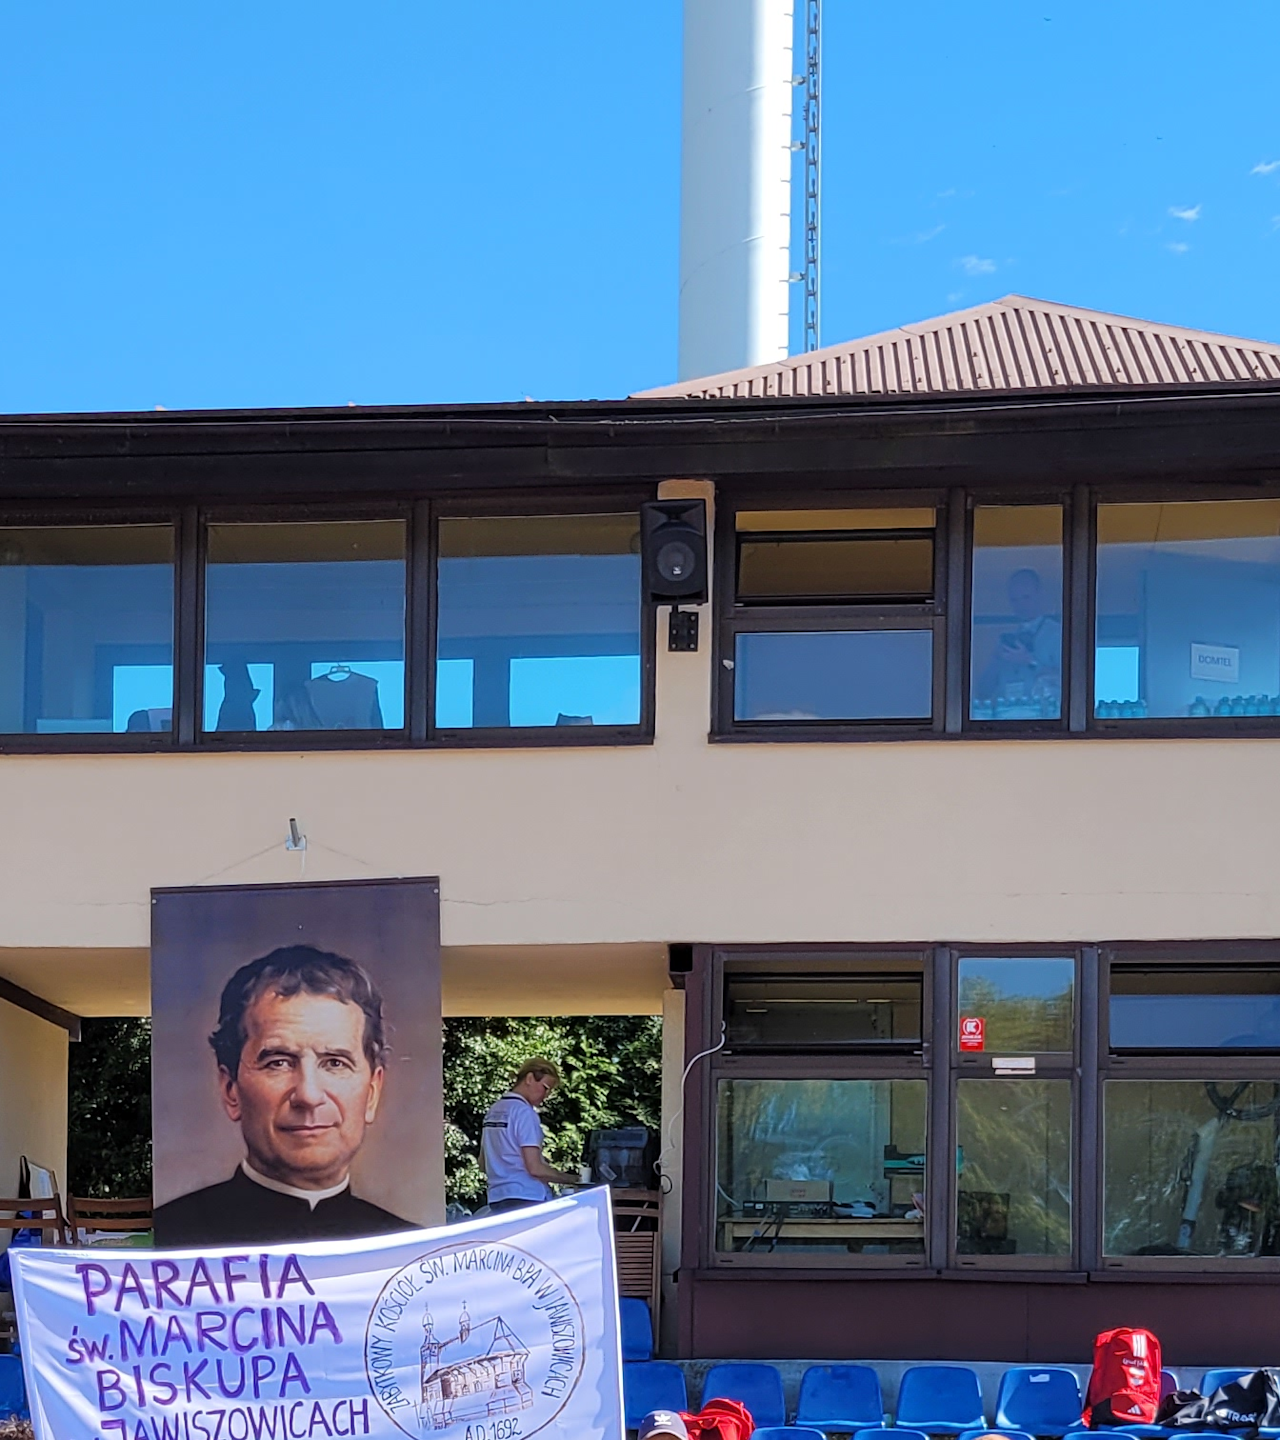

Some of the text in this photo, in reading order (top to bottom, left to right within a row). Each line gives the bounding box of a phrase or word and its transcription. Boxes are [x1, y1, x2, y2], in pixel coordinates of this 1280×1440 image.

[75, 1253, 316, 1317] PARAFIA
[119, 1301, 344, 1362] MARCINA
[453, 1248, 515, 1276] MARCINA
[531, 1295, 576, 1399] JAWISZOWICACH
[96, 1352, 312, 1412] BISKUPA
